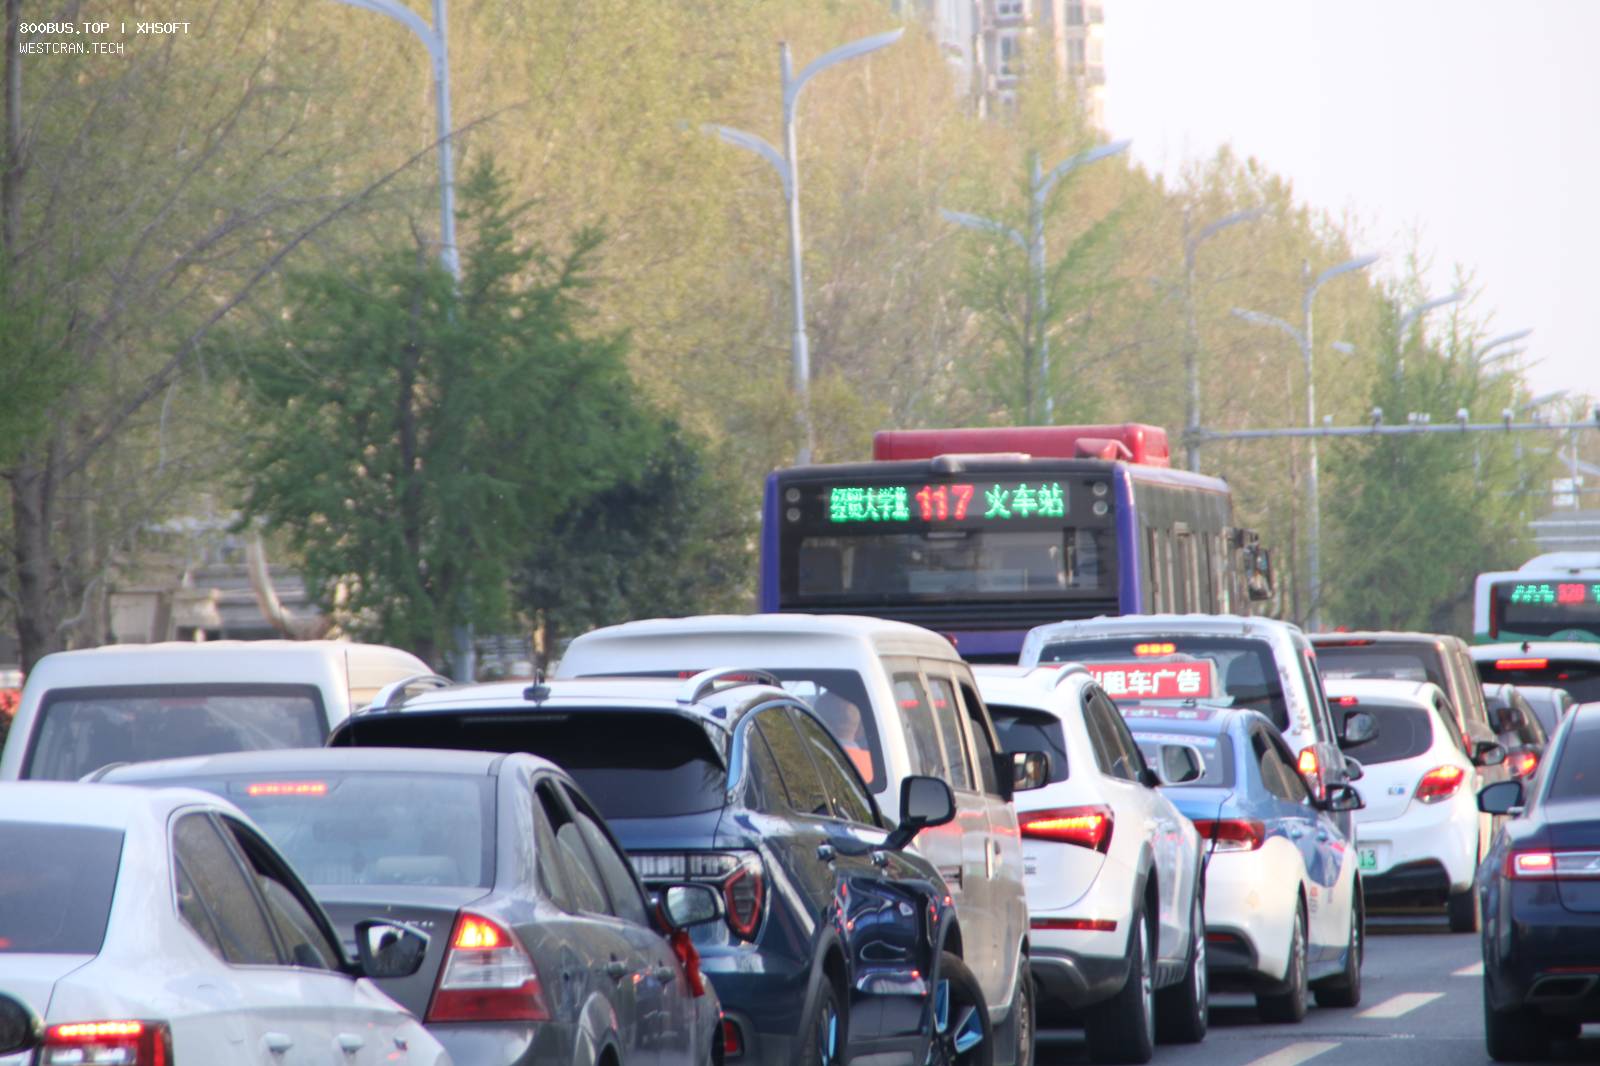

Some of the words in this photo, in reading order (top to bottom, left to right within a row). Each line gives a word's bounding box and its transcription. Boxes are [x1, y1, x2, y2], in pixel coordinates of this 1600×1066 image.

[915, 484, 974, 521] 117
[984, 482, 1065, 518] 火车站
